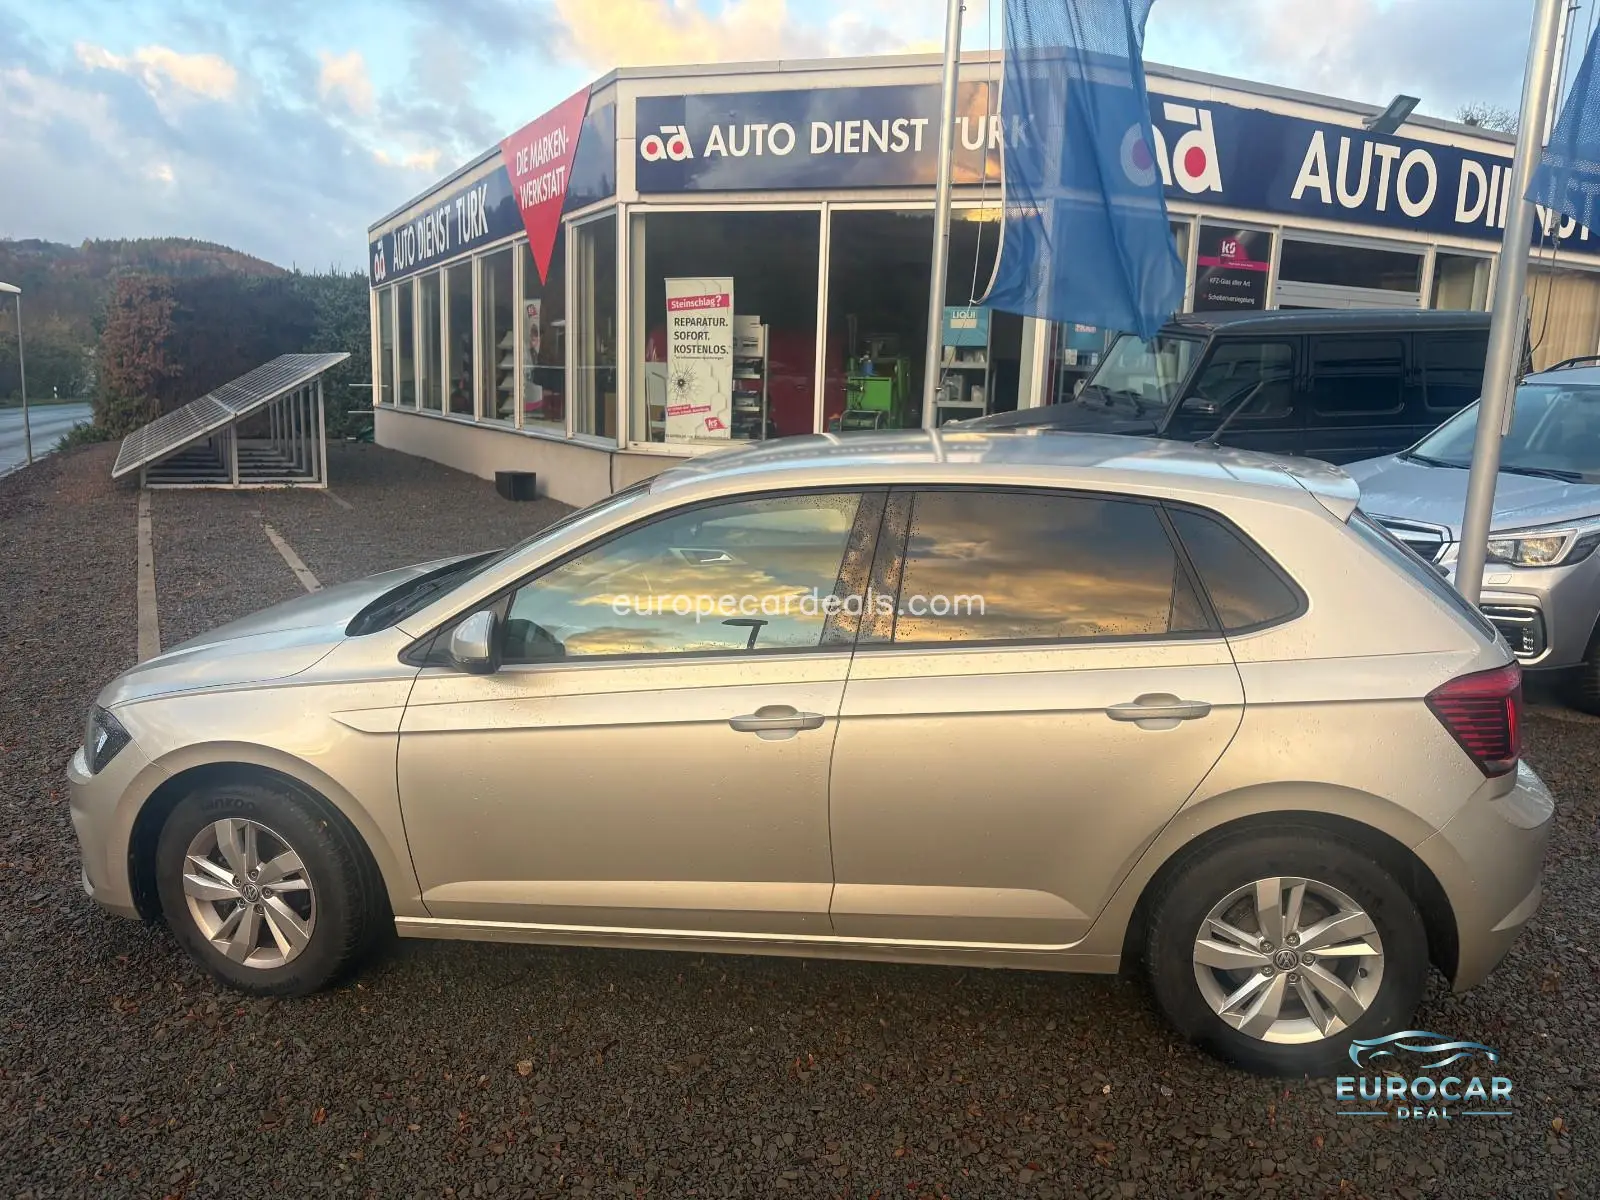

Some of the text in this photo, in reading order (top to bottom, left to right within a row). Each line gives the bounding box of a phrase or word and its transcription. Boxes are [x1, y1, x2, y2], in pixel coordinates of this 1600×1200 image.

[703, 122, 796, 157] AUTO
[809, 117, 929, 154] DIENST
[516, 125, 569, 177] DIE MARKEN-
[1290, 130, 1438, 218] AUTO
[520, 165, 566, 211] WERKSTATT
[393, 225, 416, 272] AUTO
[417, 204, 451, 261] DIENST
[456, 183, 489, 245] TURK
[671, 295, 722, 309] Steinschlag?
[952, 311, 977, 319] LIQUI
[674, 317, 729, 327] REPARATUR.
[673, 331, 710, 341] SOFORT.
[673, 344, 729, 355] KOSTENLOS.
